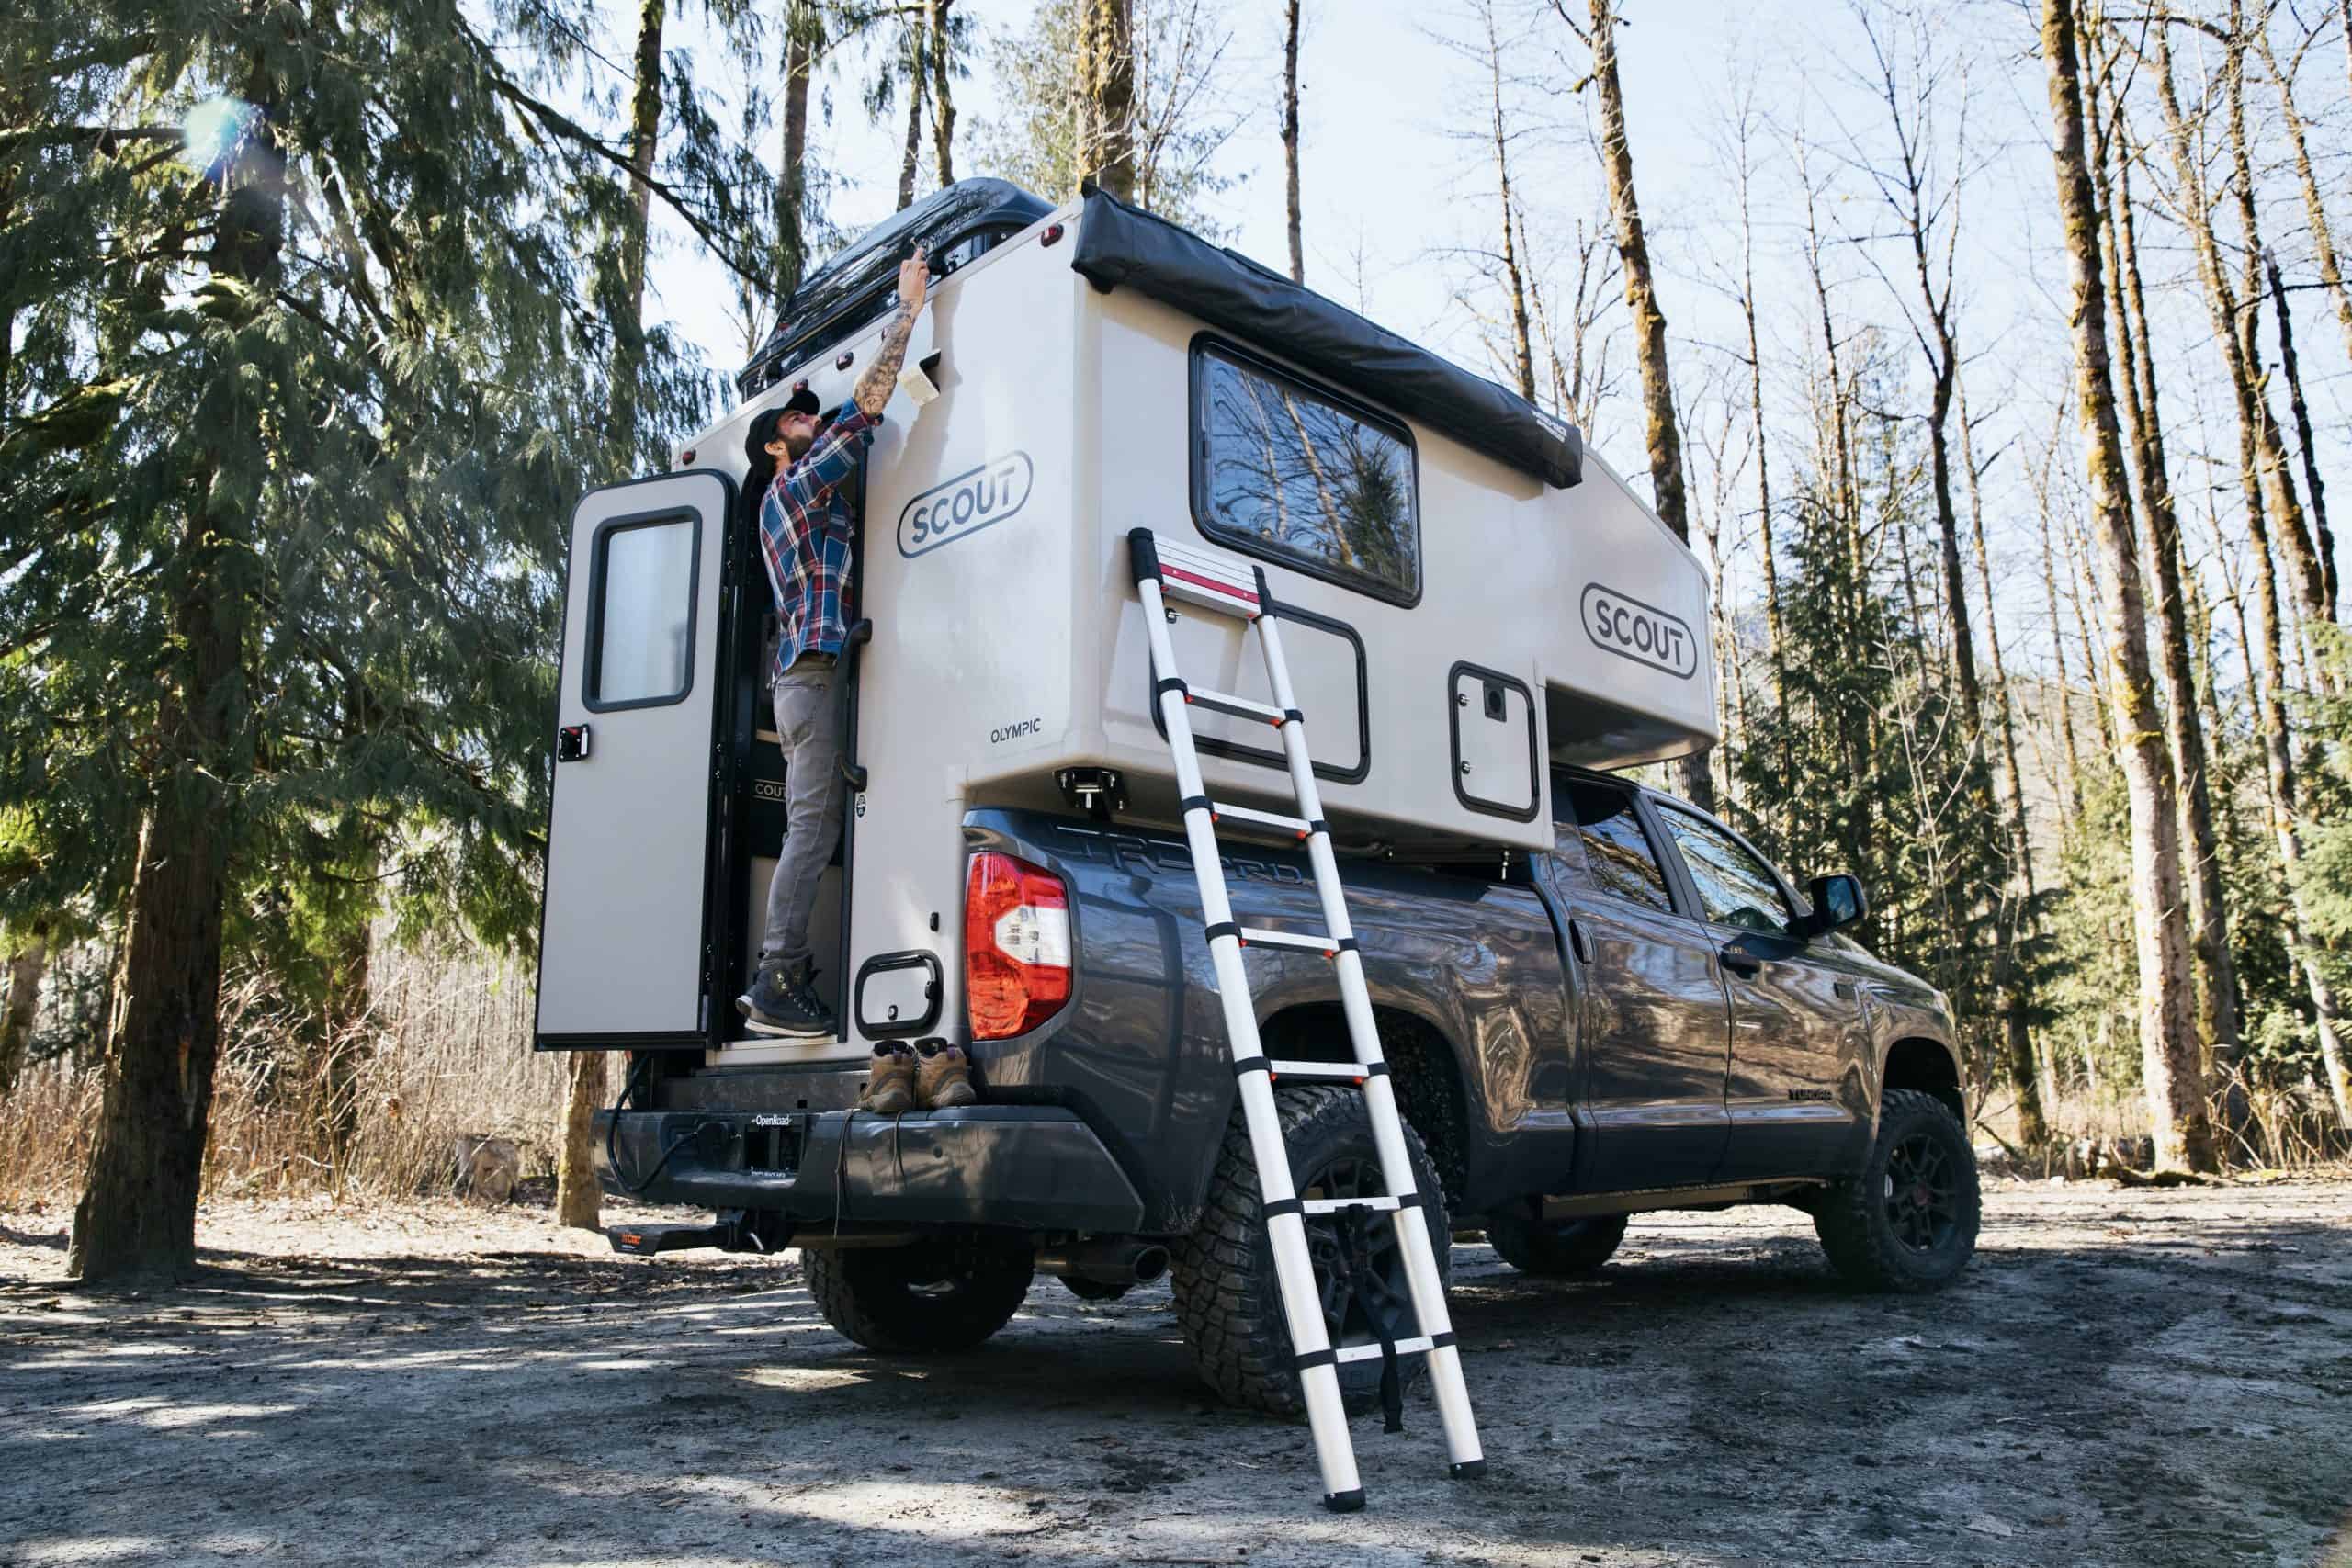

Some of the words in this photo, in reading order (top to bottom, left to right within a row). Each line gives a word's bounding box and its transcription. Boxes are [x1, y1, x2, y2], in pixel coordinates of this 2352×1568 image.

[912, 466, 1015, 544] SCOUT
[1596, 599, 1683, 666] SCOUT
[991, 718, 1041, 743] OLYMPIC
[755, 784, 787, 798] COUT
[755, 1114, 790, 1126] OpenRoad
